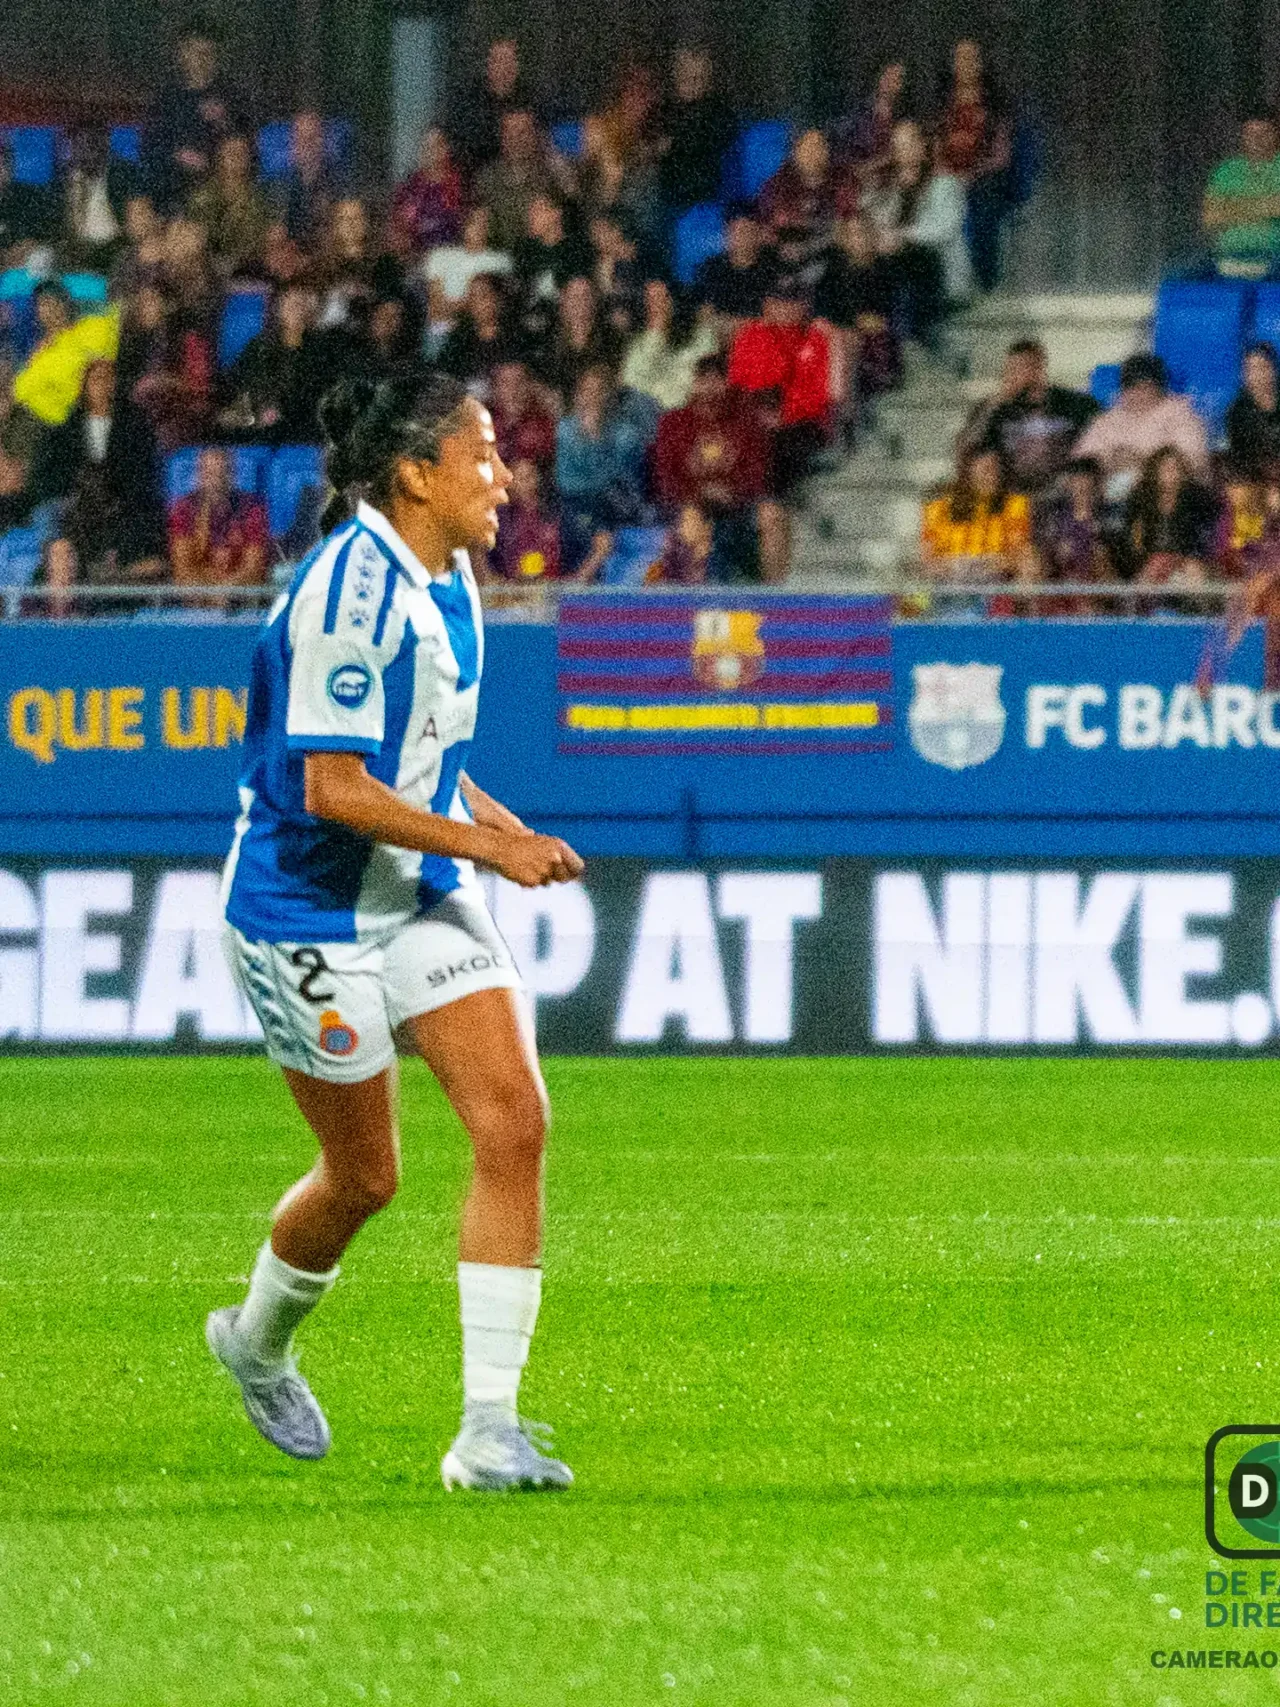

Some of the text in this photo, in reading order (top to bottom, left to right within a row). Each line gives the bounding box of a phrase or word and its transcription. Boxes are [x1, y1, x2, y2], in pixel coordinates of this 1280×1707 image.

[8, 686, 248, 766] QUE UN
[1031, 684, 1108, 749] FC
[292, 947, 336, 1002] 2
[614, 871, 818, 1043] AT
